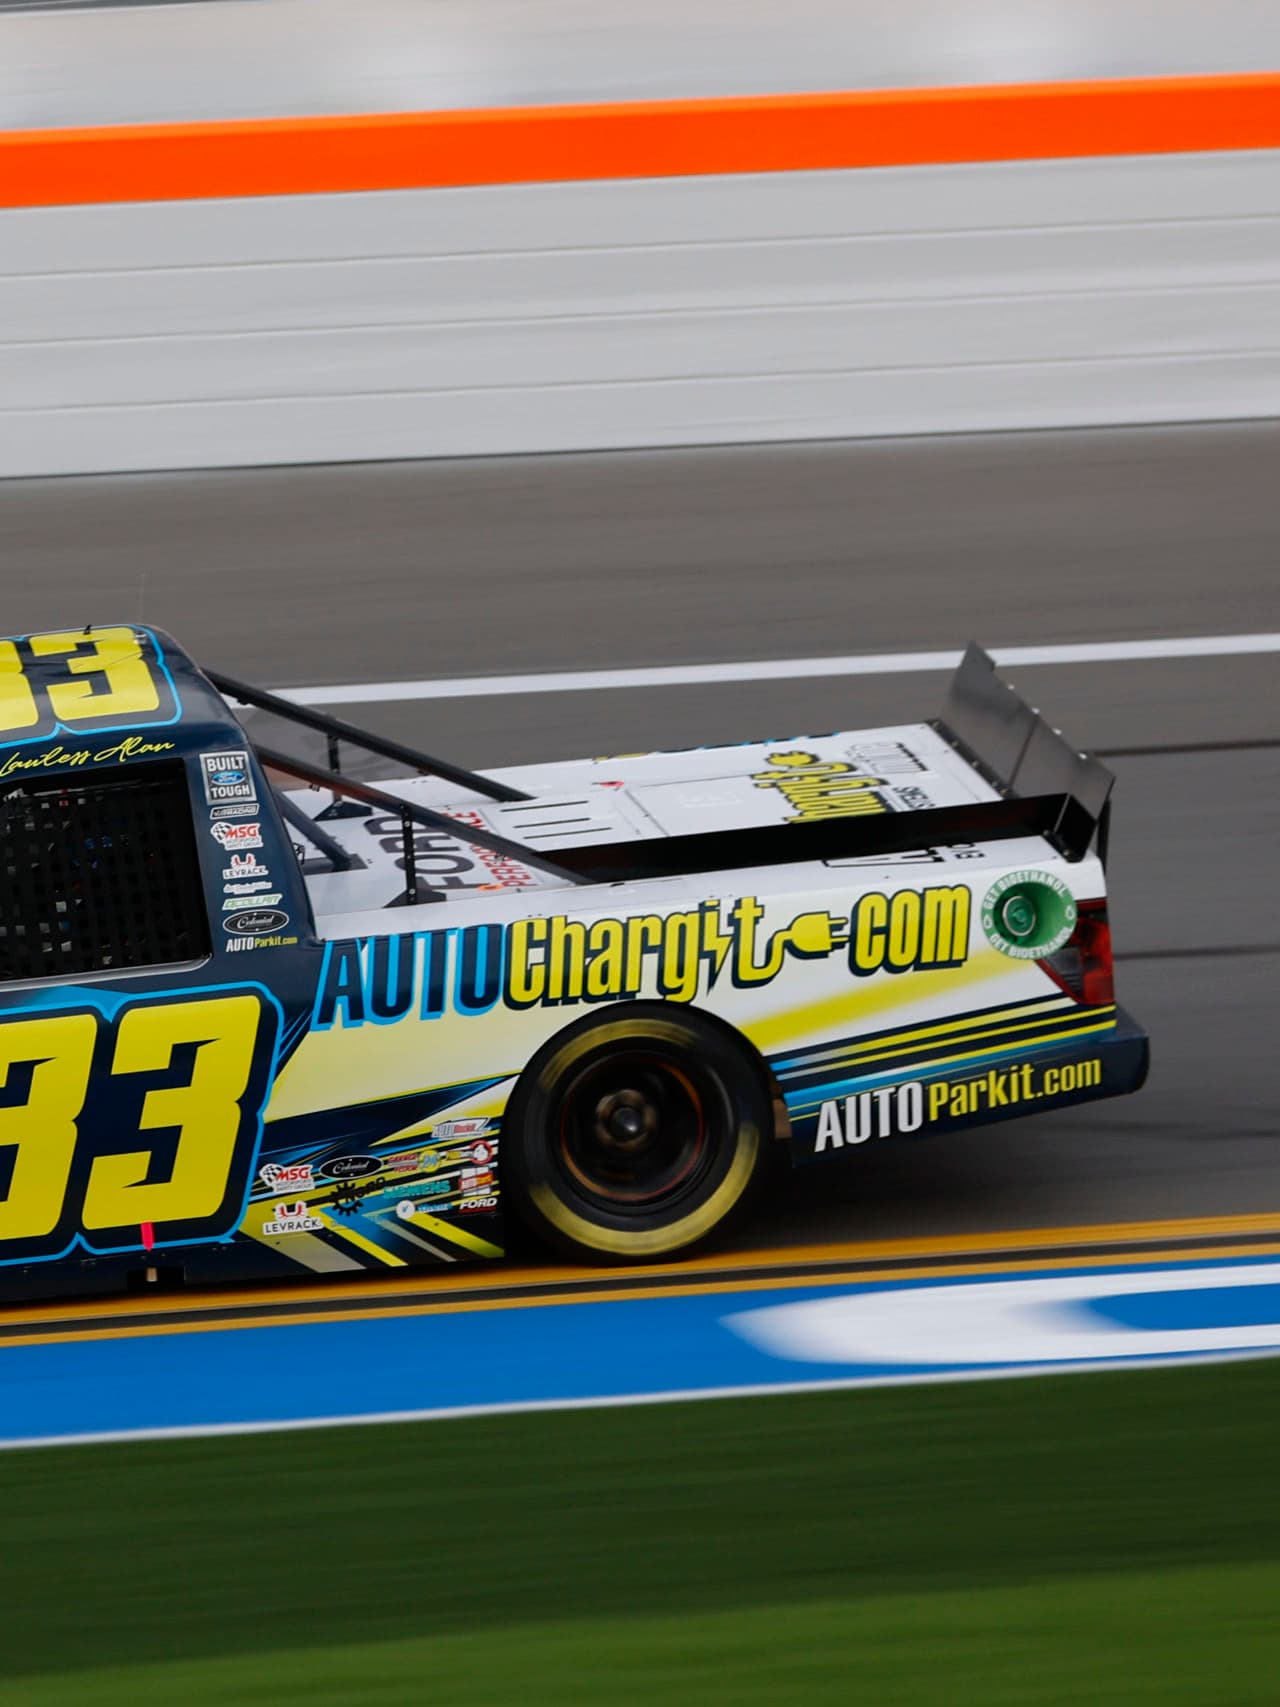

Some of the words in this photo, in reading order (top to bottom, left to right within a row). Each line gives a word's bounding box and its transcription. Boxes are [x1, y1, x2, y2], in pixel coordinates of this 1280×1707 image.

[93, 736, 176, 762] Alan
[206, 756, 245, 772] BUILT
[211, 784, 251, 799] TOUGH
[225, 825, 258, 839] MSG
[224, 867, 265, 878] LEVRACK
[276, 1166, 311, 1181] MSG
[460, 1198, 497, 1210] FORD
[265, 1218, 318, 1234] LEVRACK
